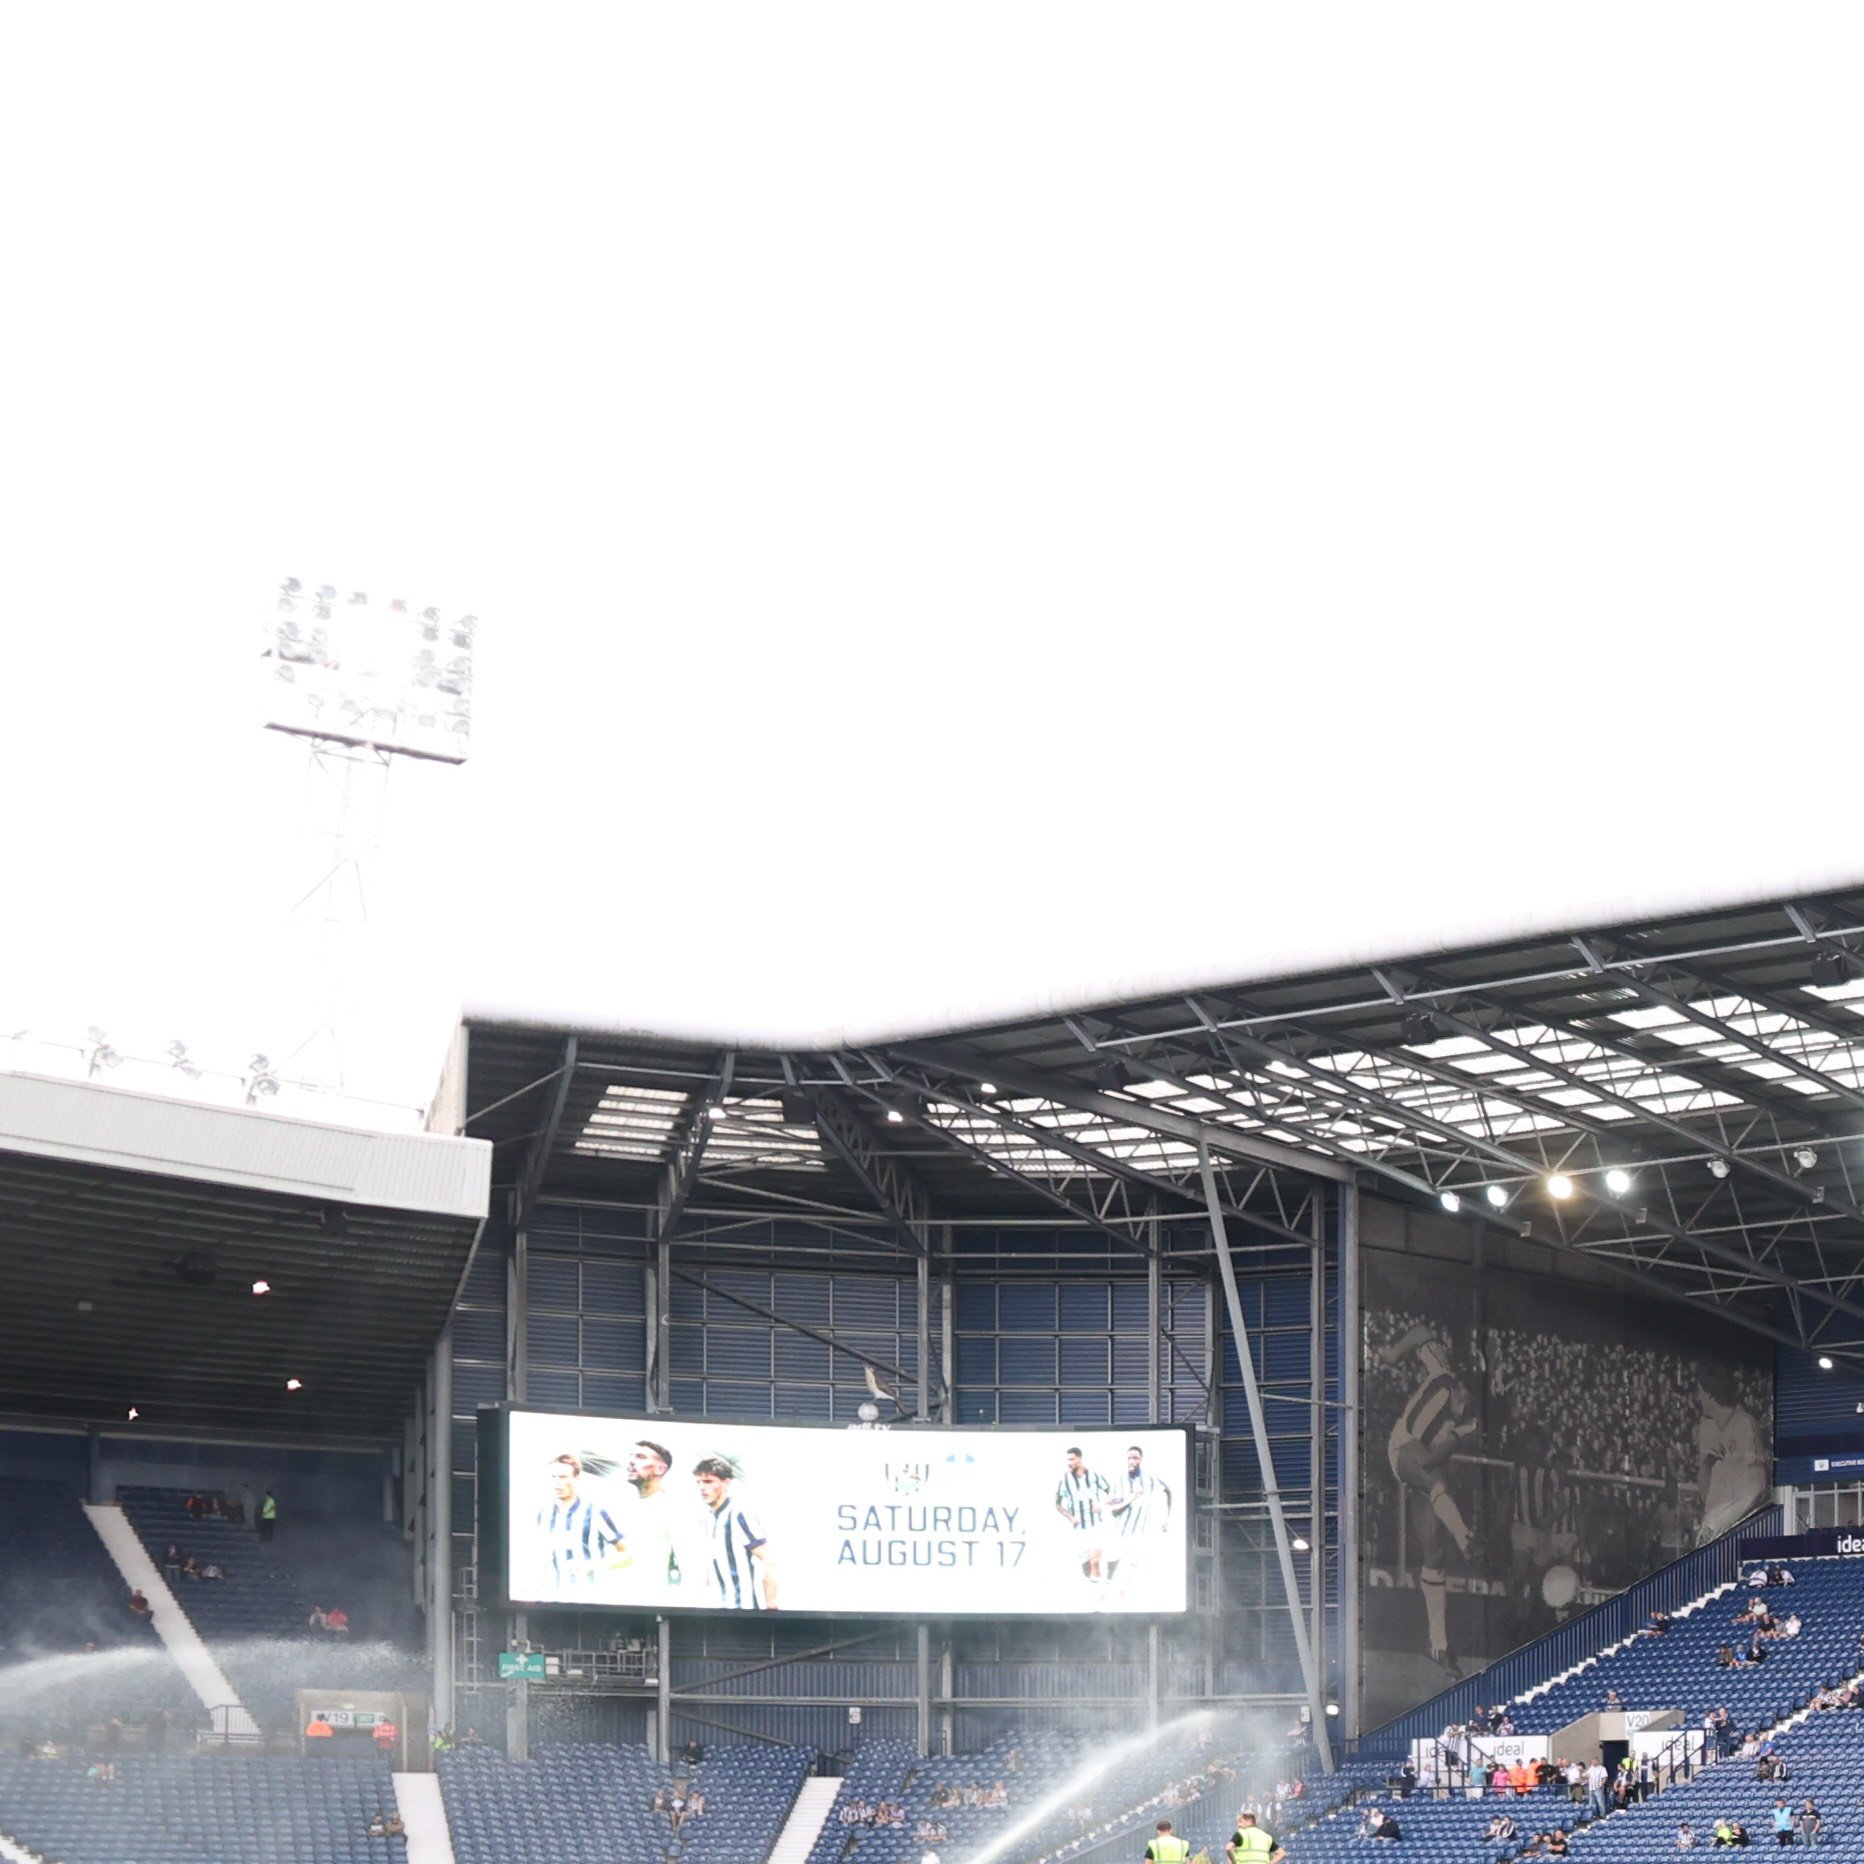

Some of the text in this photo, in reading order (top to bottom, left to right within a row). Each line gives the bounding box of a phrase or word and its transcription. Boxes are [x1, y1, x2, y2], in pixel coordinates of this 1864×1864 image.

[837, 1505, 1025, 1536] SATURDAY,
[837, 1540, 1026, 1567] AUGUST 17
[1626, 1714, 1650, 1728] V20
[1493, 1741, 1524, 1757] ideal
